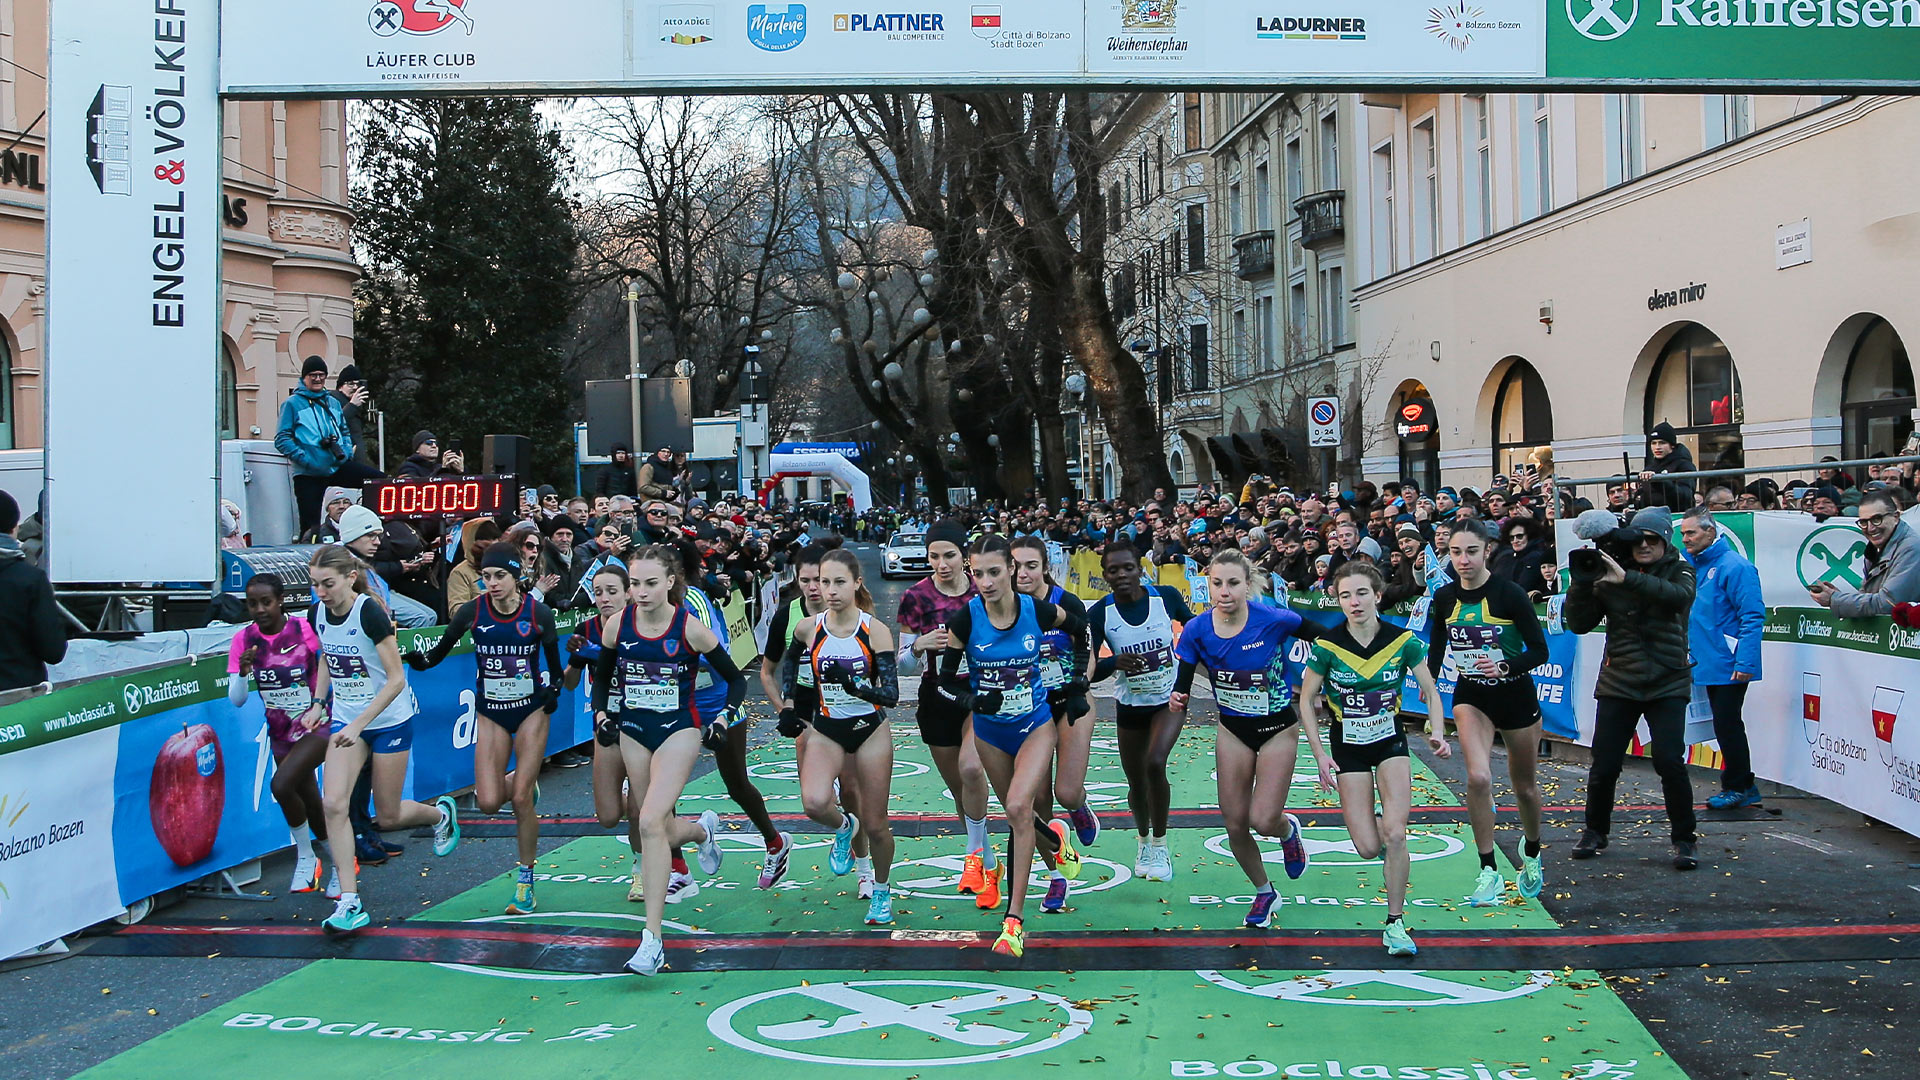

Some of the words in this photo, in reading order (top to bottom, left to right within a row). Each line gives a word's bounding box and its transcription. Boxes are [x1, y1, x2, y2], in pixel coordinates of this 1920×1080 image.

[750, 13, 804, 39] Marlene
[851, 14, 944, 32] PLATTNER
[1257, 17, 1366, 33] LADURNER
[1465, 20, 1496, 30] Bolzano
[1498, 20, 1522, 30] Bozen
[1001, 31, 1023, 40] Città
[1025, 31, 1034, 40] di
[1036, 31, 1071, 40] Bolzano
[990, 40, 1014, 49] Stadt
[1016, 40, 1044, 49] Bozen
[1106, 36, 1188, 54] Weihenstephan
[366, 51, 428, 68] LÄUFER
[433, 53, 476, 67] CLUB
[381, 73, 409, 81] BOZEN
[412, 72, 460, 80] RAIFFEISEN
[154, 159, 185, 185] &
[153, 190, 185, 327] ENGEL
[1647, 289, 1678, 311] elena
[1450, 627, 1469, 640] 64
[1804, 620, 1833, 637] Raiffeisen
[486, 658, 503, 670] 59
[626, 662, 645, 674] 55
[259, 669, 277, 682] 53
[983, 669, 1000, 681] 51
[1217, 670, 1235, 682] 57
[142, 679, 200, 705] Raiffeisen
[644, 688, 675, 696] BUONO
[1222, 690, 1260, 701] GEMETTO
[1345, 694, 1365, 707] 65
[44, 702, 116, 733] www.boclassic.it
[1351, 716, 1388, 728] PALUMBO
[1840, 738, 1867, 762] Bolzano
[48, 820, 84, 846] Bozen
[222, 1012, 532, 1043] BOclassic
